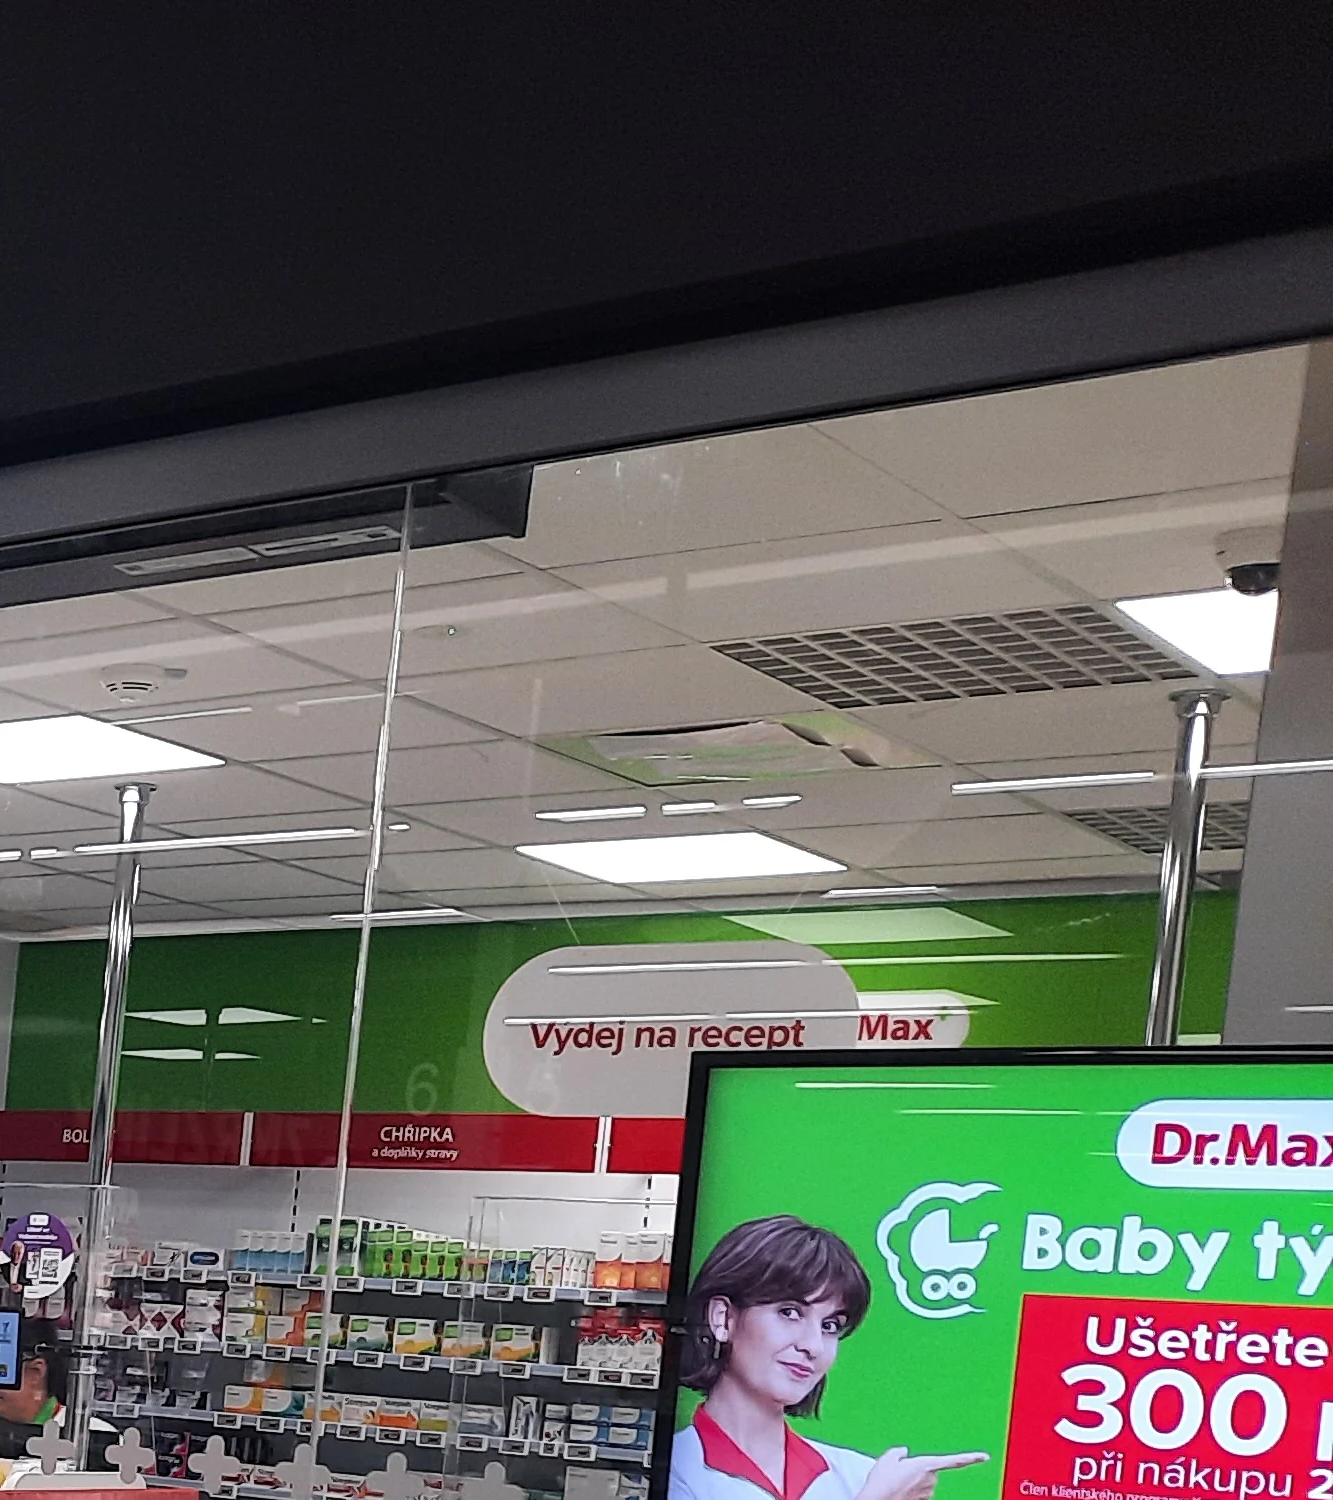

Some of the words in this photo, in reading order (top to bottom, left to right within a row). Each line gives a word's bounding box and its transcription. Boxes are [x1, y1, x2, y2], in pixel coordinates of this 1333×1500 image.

[635, 1026, 675, 1047] na
[687, 1019, 806, 1050] recept
[380, 1124, 454, 1143] CHŘIPKA
[381, 1146, 423, 1161] doplňky
[424, 1148, 458, 1161] stravy
[1022, 1213, 1230, 1292] Baby
[1252, 1219, 1333, 1296] tý
[1086, 1315, 1328, 1367] Ušetřete
[1054, 1363, 1288, 1457] 300
[1073, 1450, 1123, 1487] při
[1019, 1480, 1048, 1496] Člen
